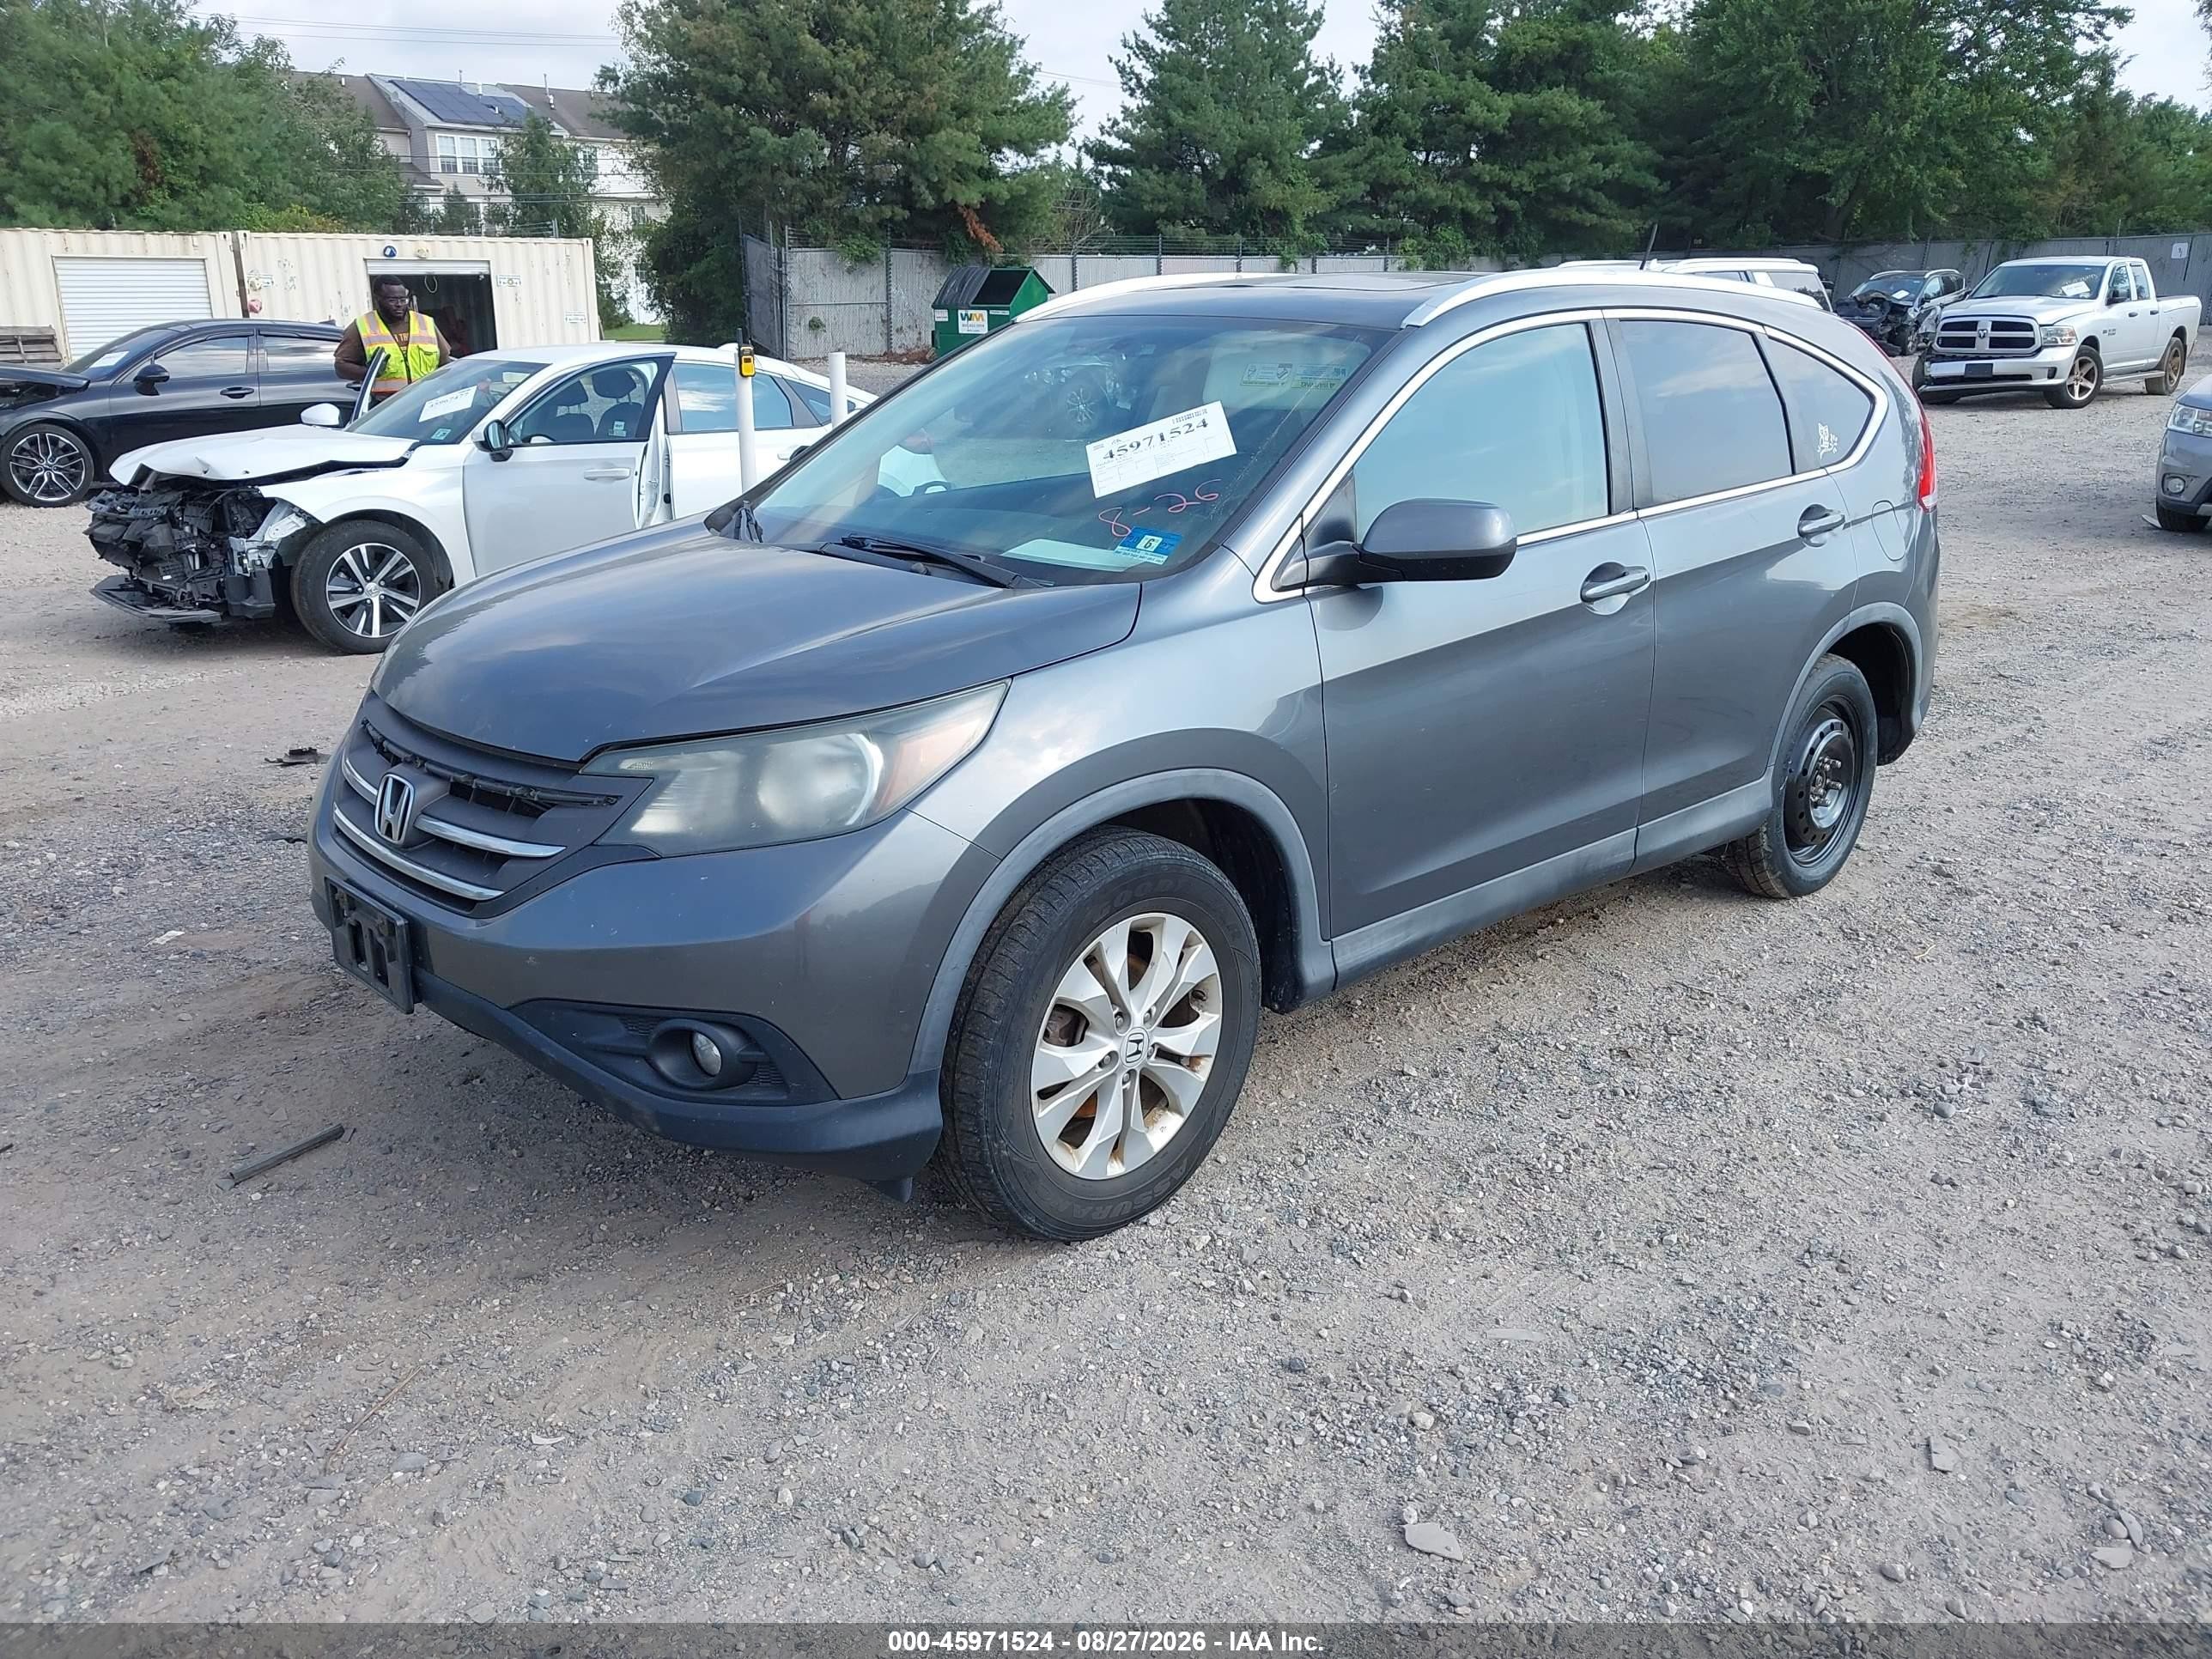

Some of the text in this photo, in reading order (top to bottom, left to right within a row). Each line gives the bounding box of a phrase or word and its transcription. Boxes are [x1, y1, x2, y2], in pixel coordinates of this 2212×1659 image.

[960, 313, 984, 321] WM
[1103, 418, 1209, 459] 45971524
[1143, 538, 1155, 549] 6
